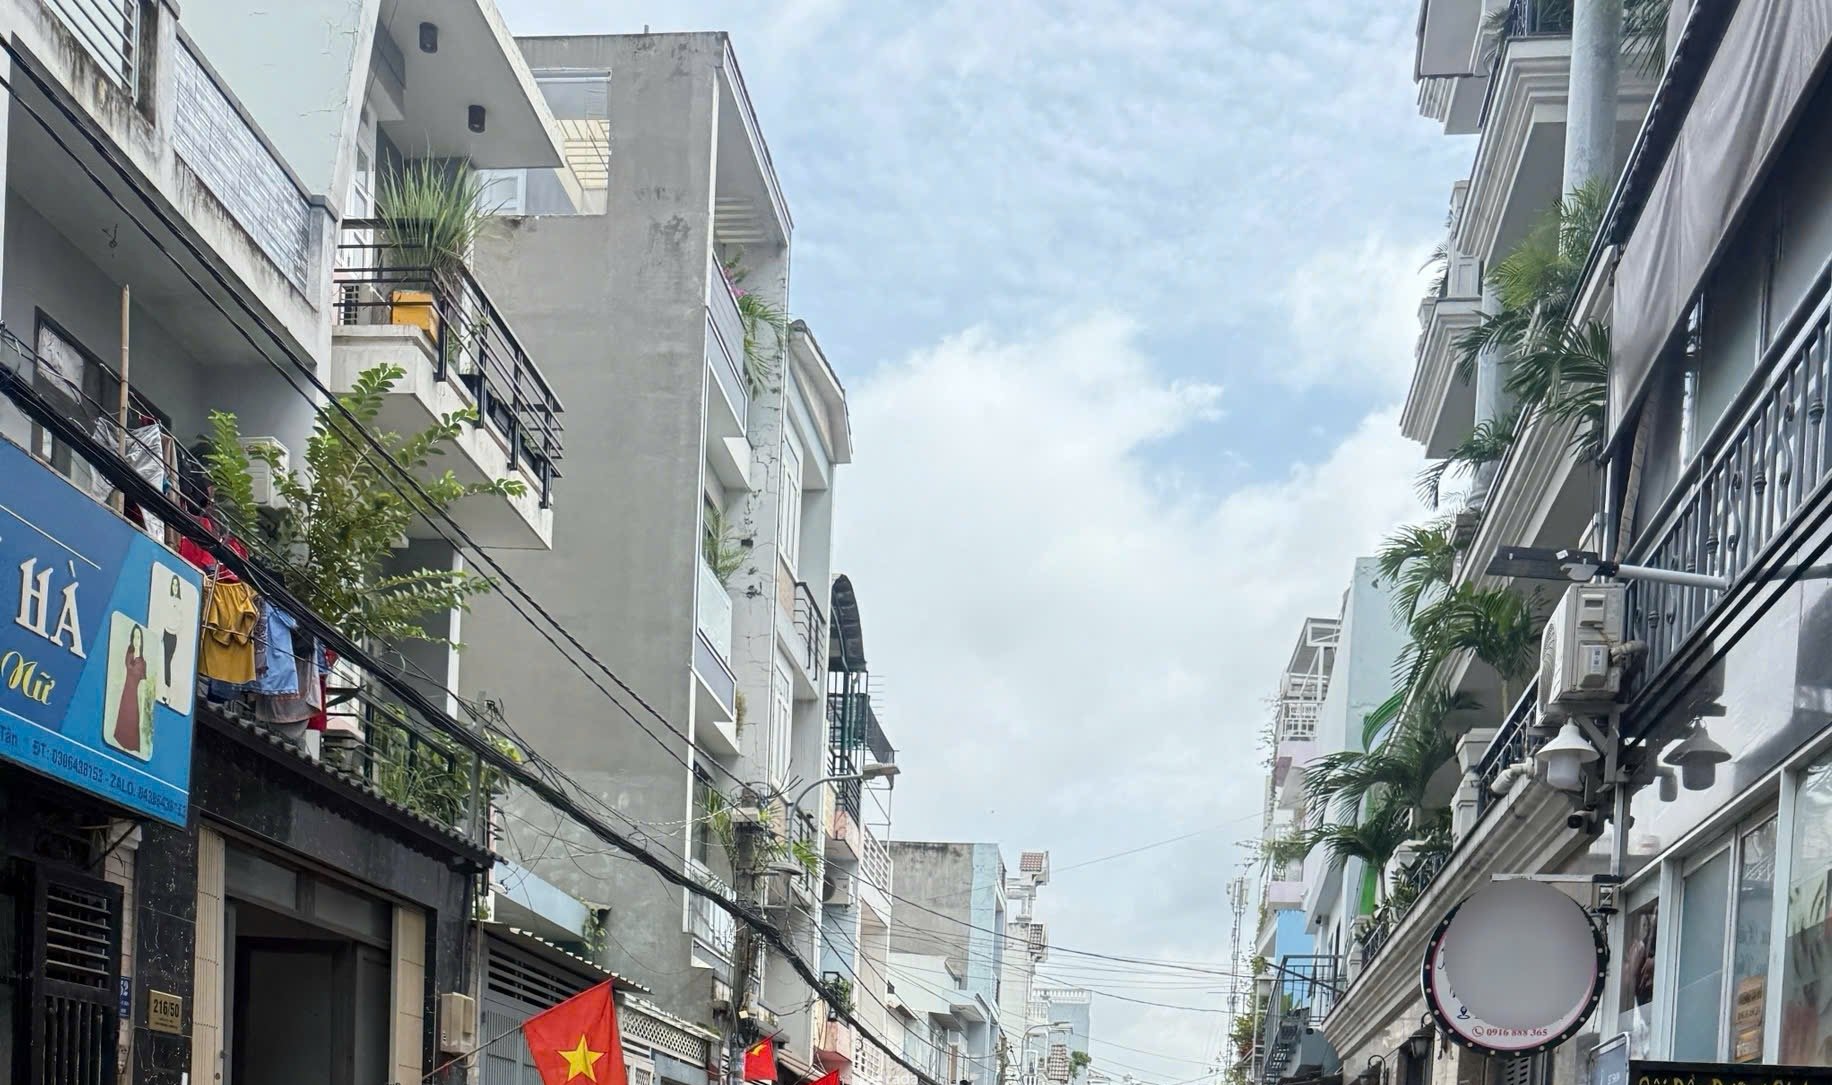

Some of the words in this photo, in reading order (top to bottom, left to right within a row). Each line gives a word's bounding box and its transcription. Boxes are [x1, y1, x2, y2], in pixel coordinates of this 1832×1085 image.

[14, 556, 87, 660] HÀ
[1, 650, 56, 706] Nữ
[153, 999, 180, 1018] 216/50
[1486, 1027, 1509, 1037] 0916
[1511, 1028, 1528, 1037] 888
[1530, 1028, 1548, 1037] 365
